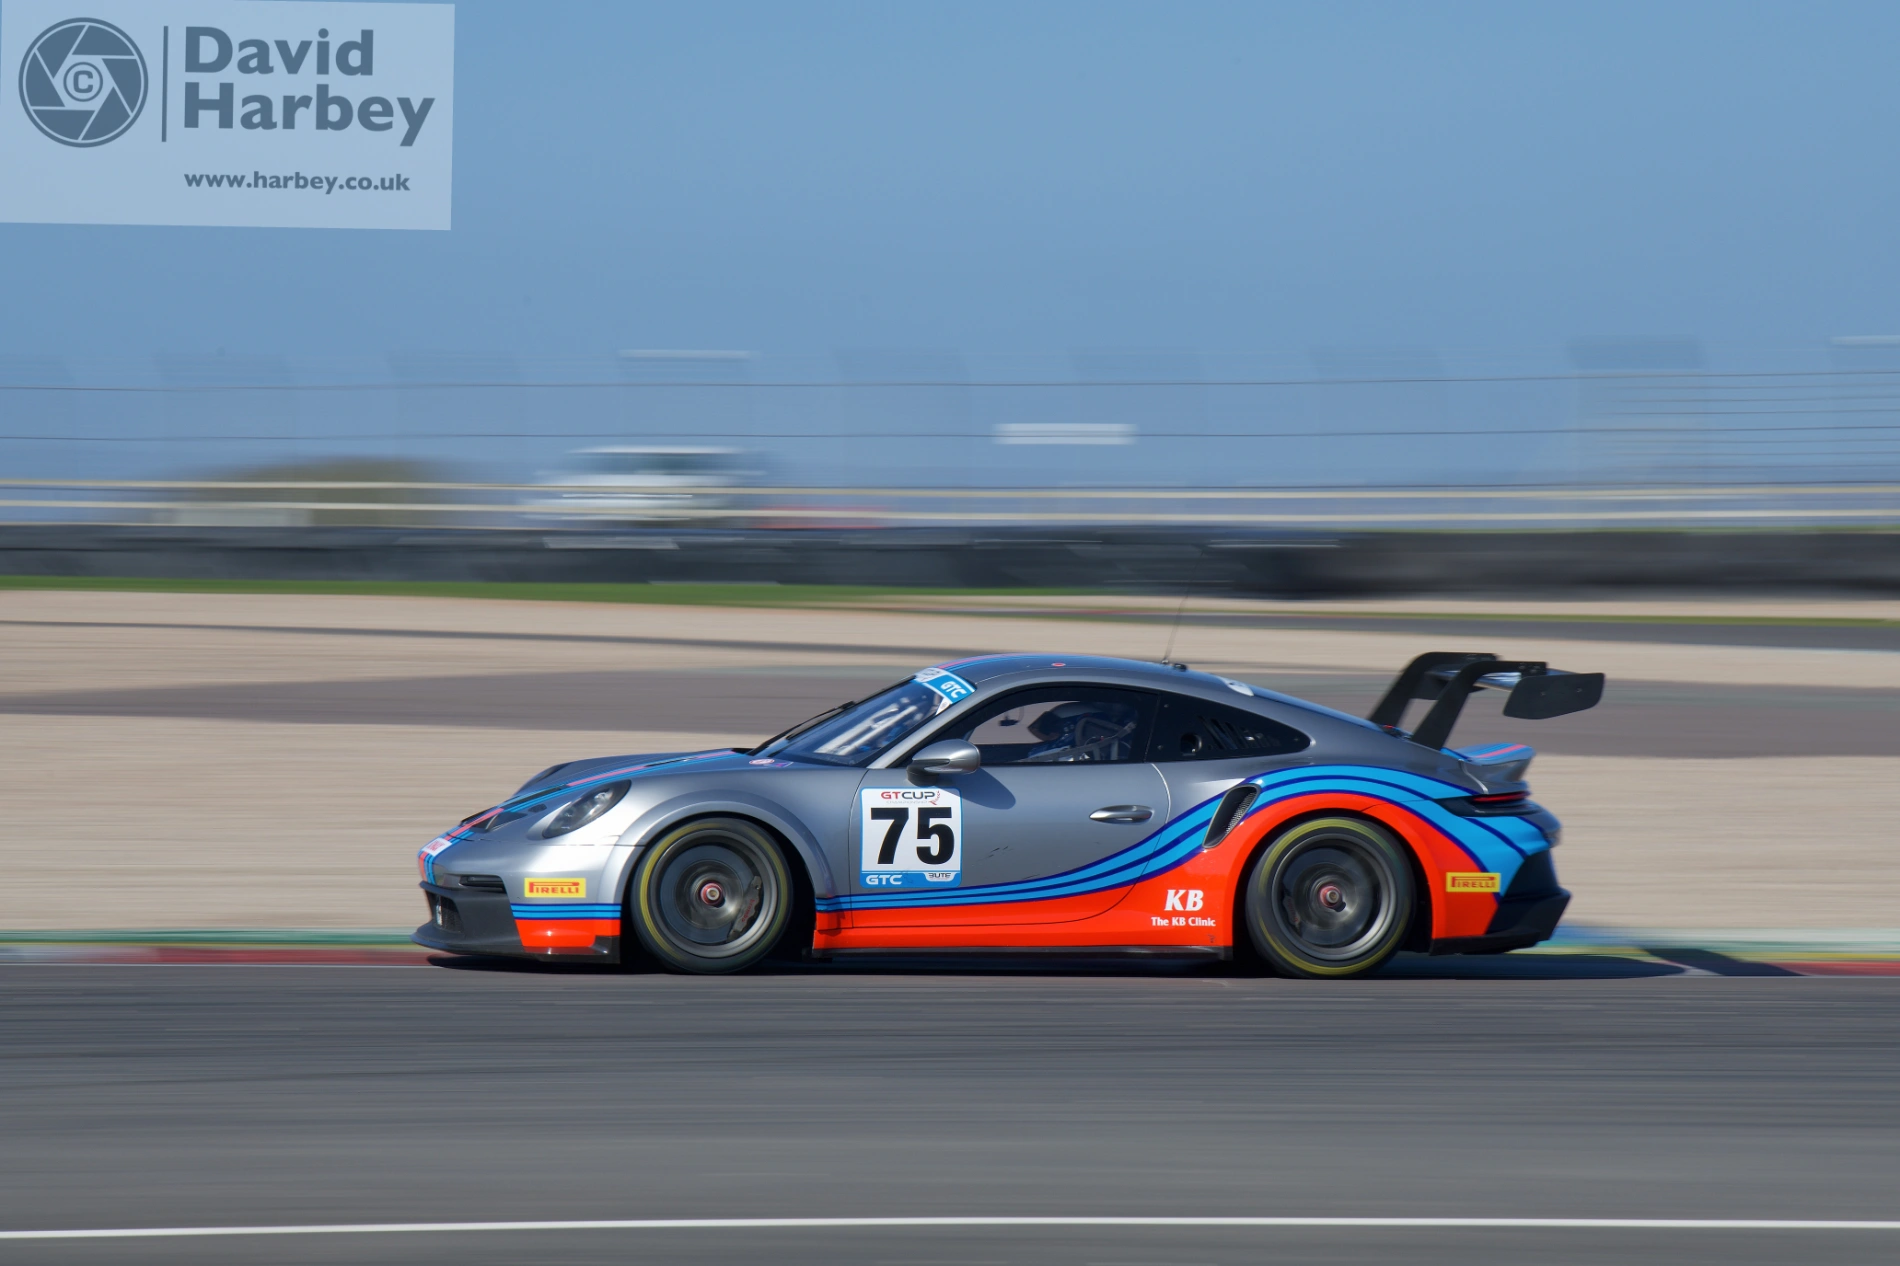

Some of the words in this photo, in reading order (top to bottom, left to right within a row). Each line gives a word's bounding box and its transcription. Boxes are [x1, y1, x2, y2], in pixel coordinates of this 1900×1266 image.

[940, 681, 967, 698] GTC
[870, 807, 955, 865] 75
[865, 874, 903, 885] GTC
[1451, 876, 1496, 888] PIRELLI
[528, 881, 580, 894] PIRELLI
[1164, 889, 1204, 911] KB
[1151, 917, 1169, 926] The
[1172, 917, 1186, 926] KB
[1188, 917, 1216, 927] Clinic
